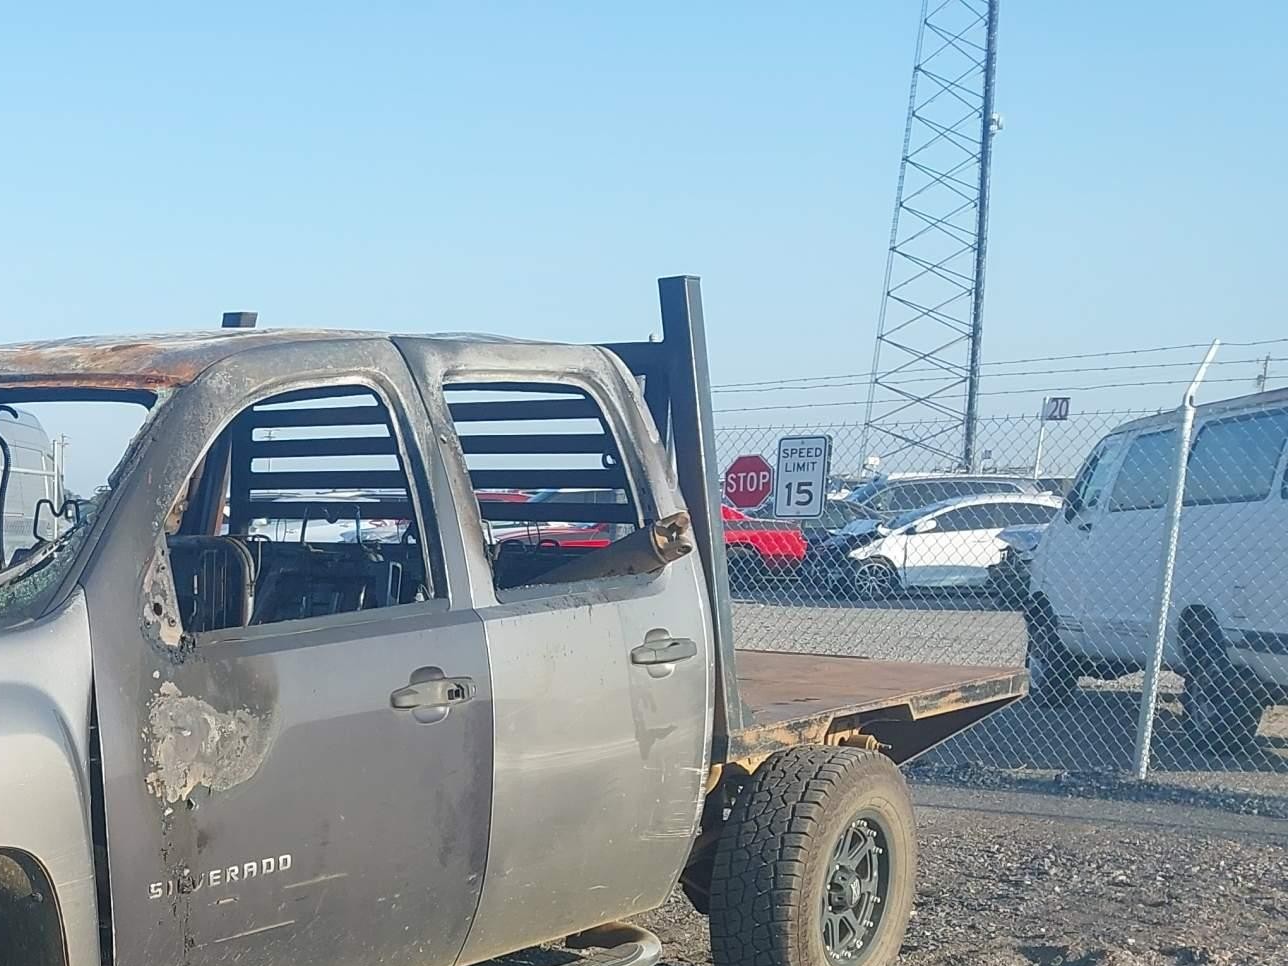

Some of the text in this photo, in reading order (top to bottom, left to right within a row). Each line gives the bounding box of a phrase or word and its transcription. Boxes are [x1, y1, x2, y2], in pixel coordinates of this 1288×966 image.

[1048, 399, 1070, 419] 20
[782, 447, 823, 459] SPEED
[784, 461, 818, 473] LIMIT
[726, 471, 770, 493] STOP
[785, 481, 813, 507] 15
